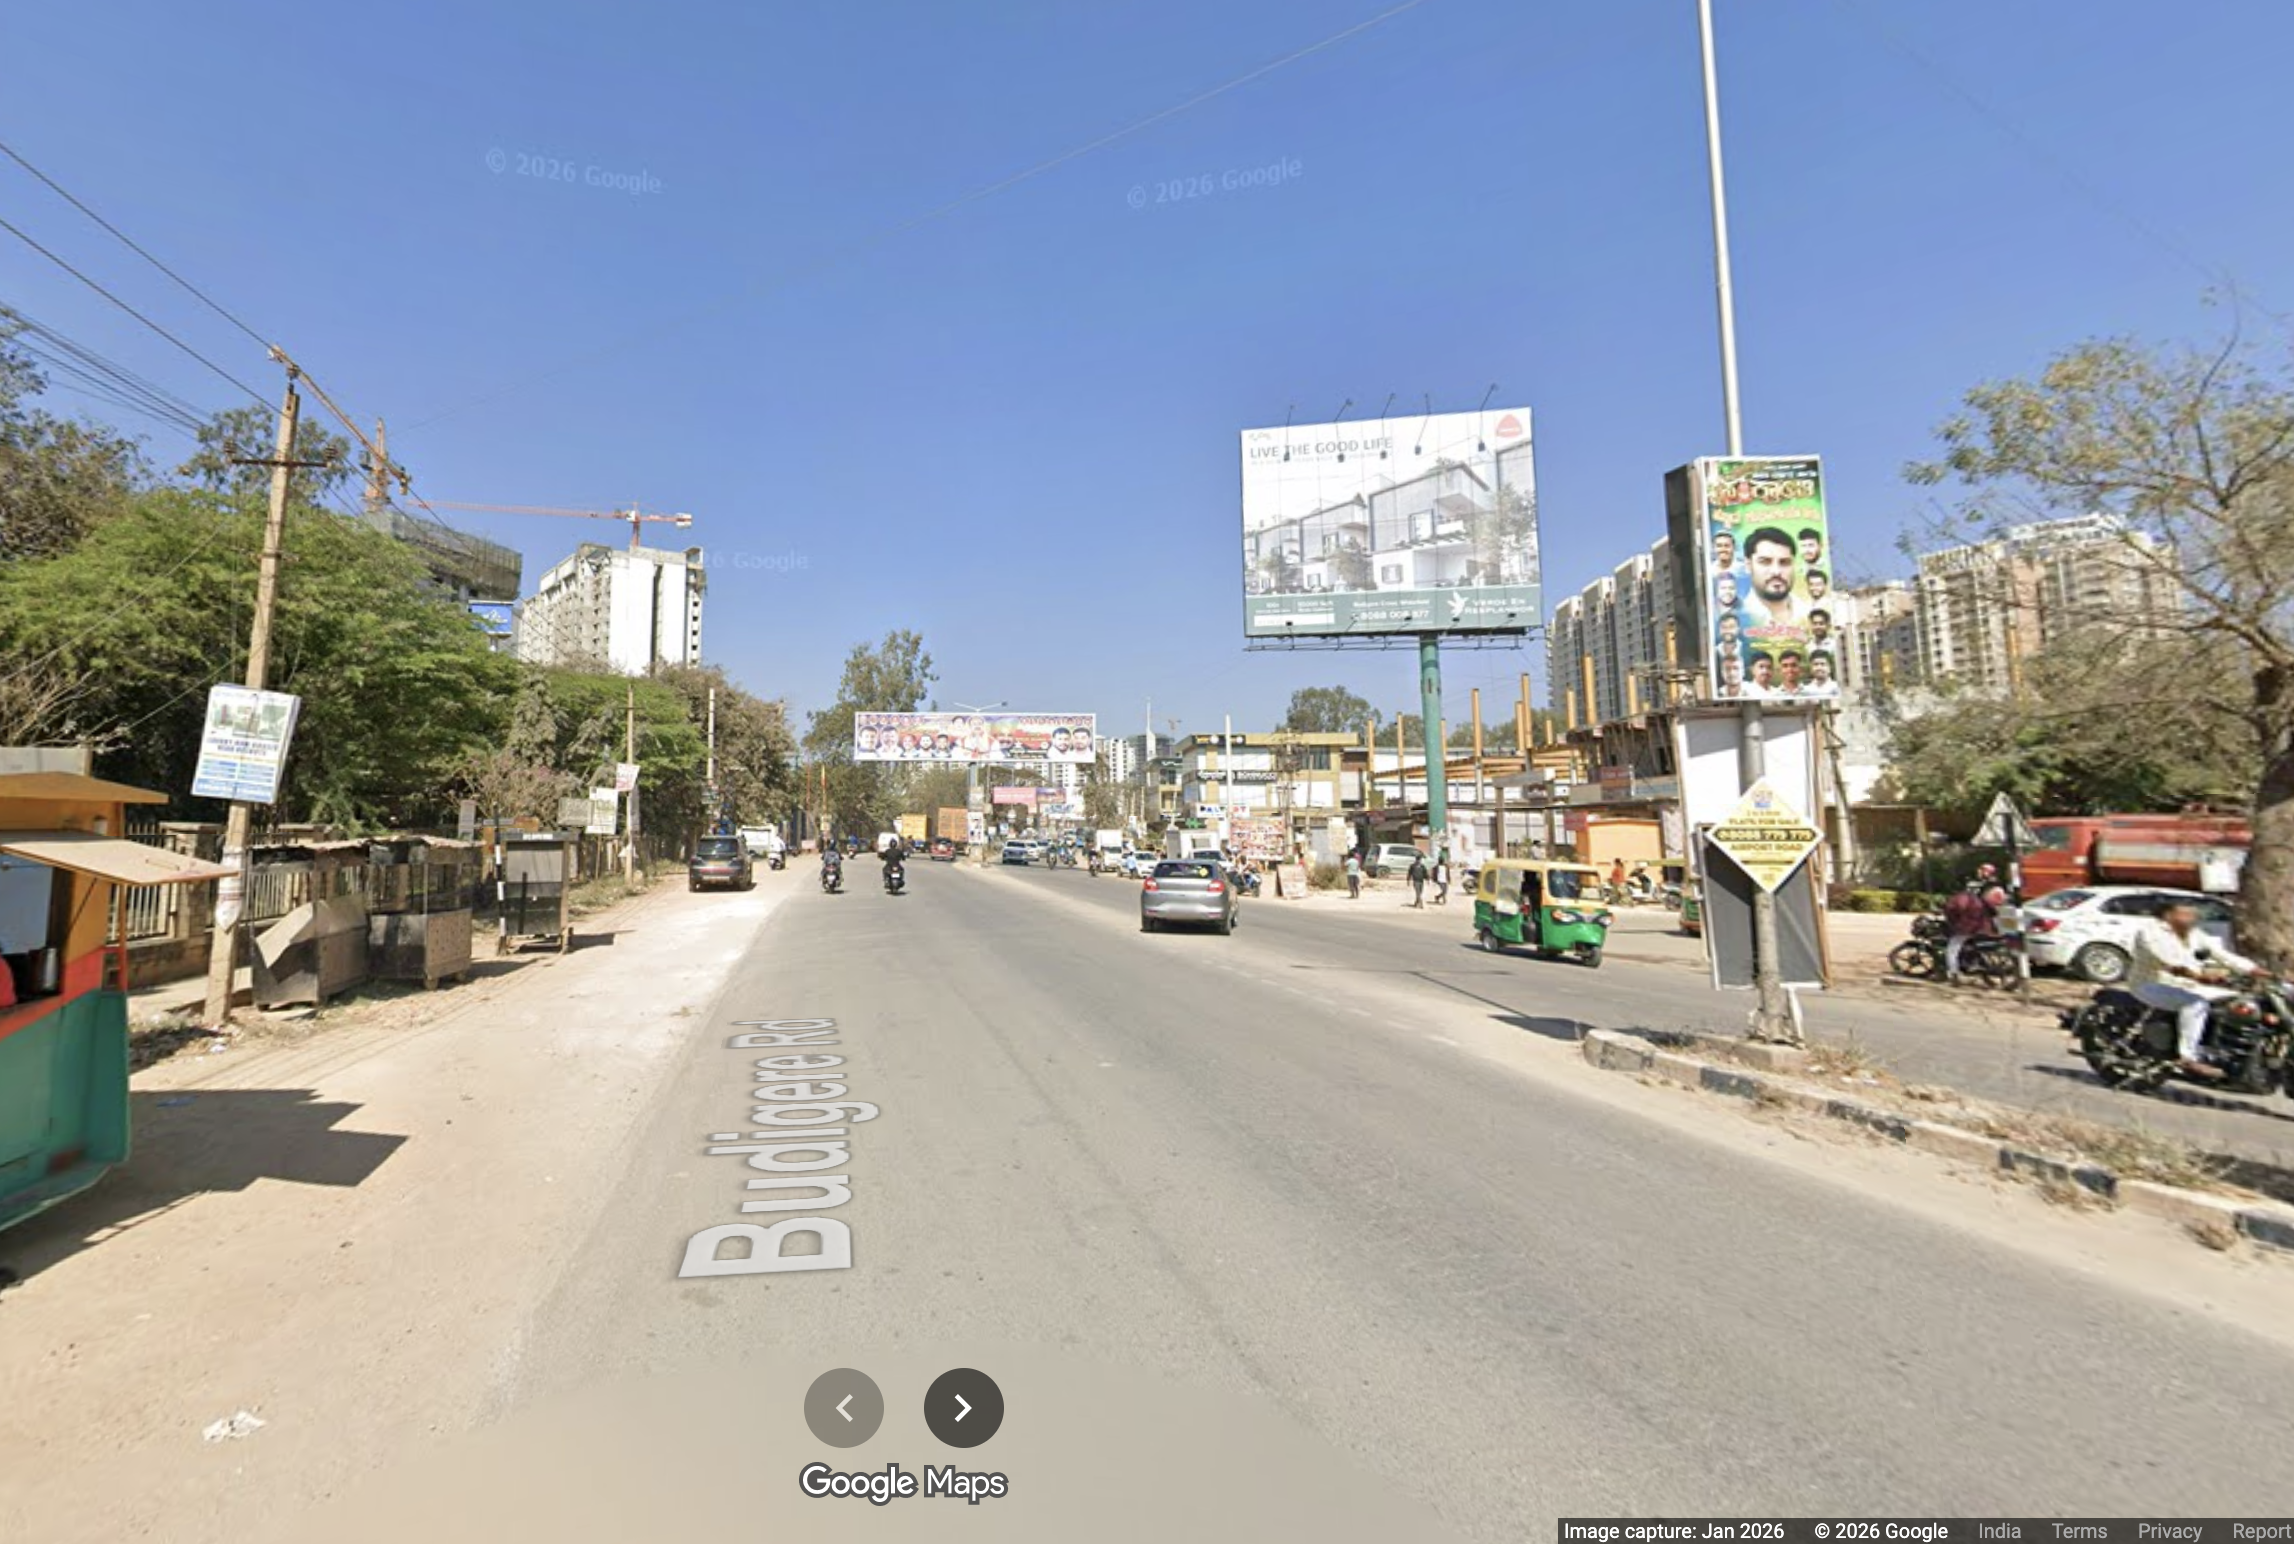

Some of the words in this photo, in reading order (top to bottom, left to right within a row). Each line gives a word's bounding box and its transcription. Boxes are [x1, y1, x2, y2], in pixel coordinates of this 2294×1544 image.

[1250, 446, 1279, 458] LIVE
[1284, 443, 1310, 456] THE
[1315, 441, 1359, 454] GOOD
[1363, 437, 1393, 450] LIFE
[1731, 843, 1772, 851] AIRPORT
[1774, 843, 1803, 851] ROAD
